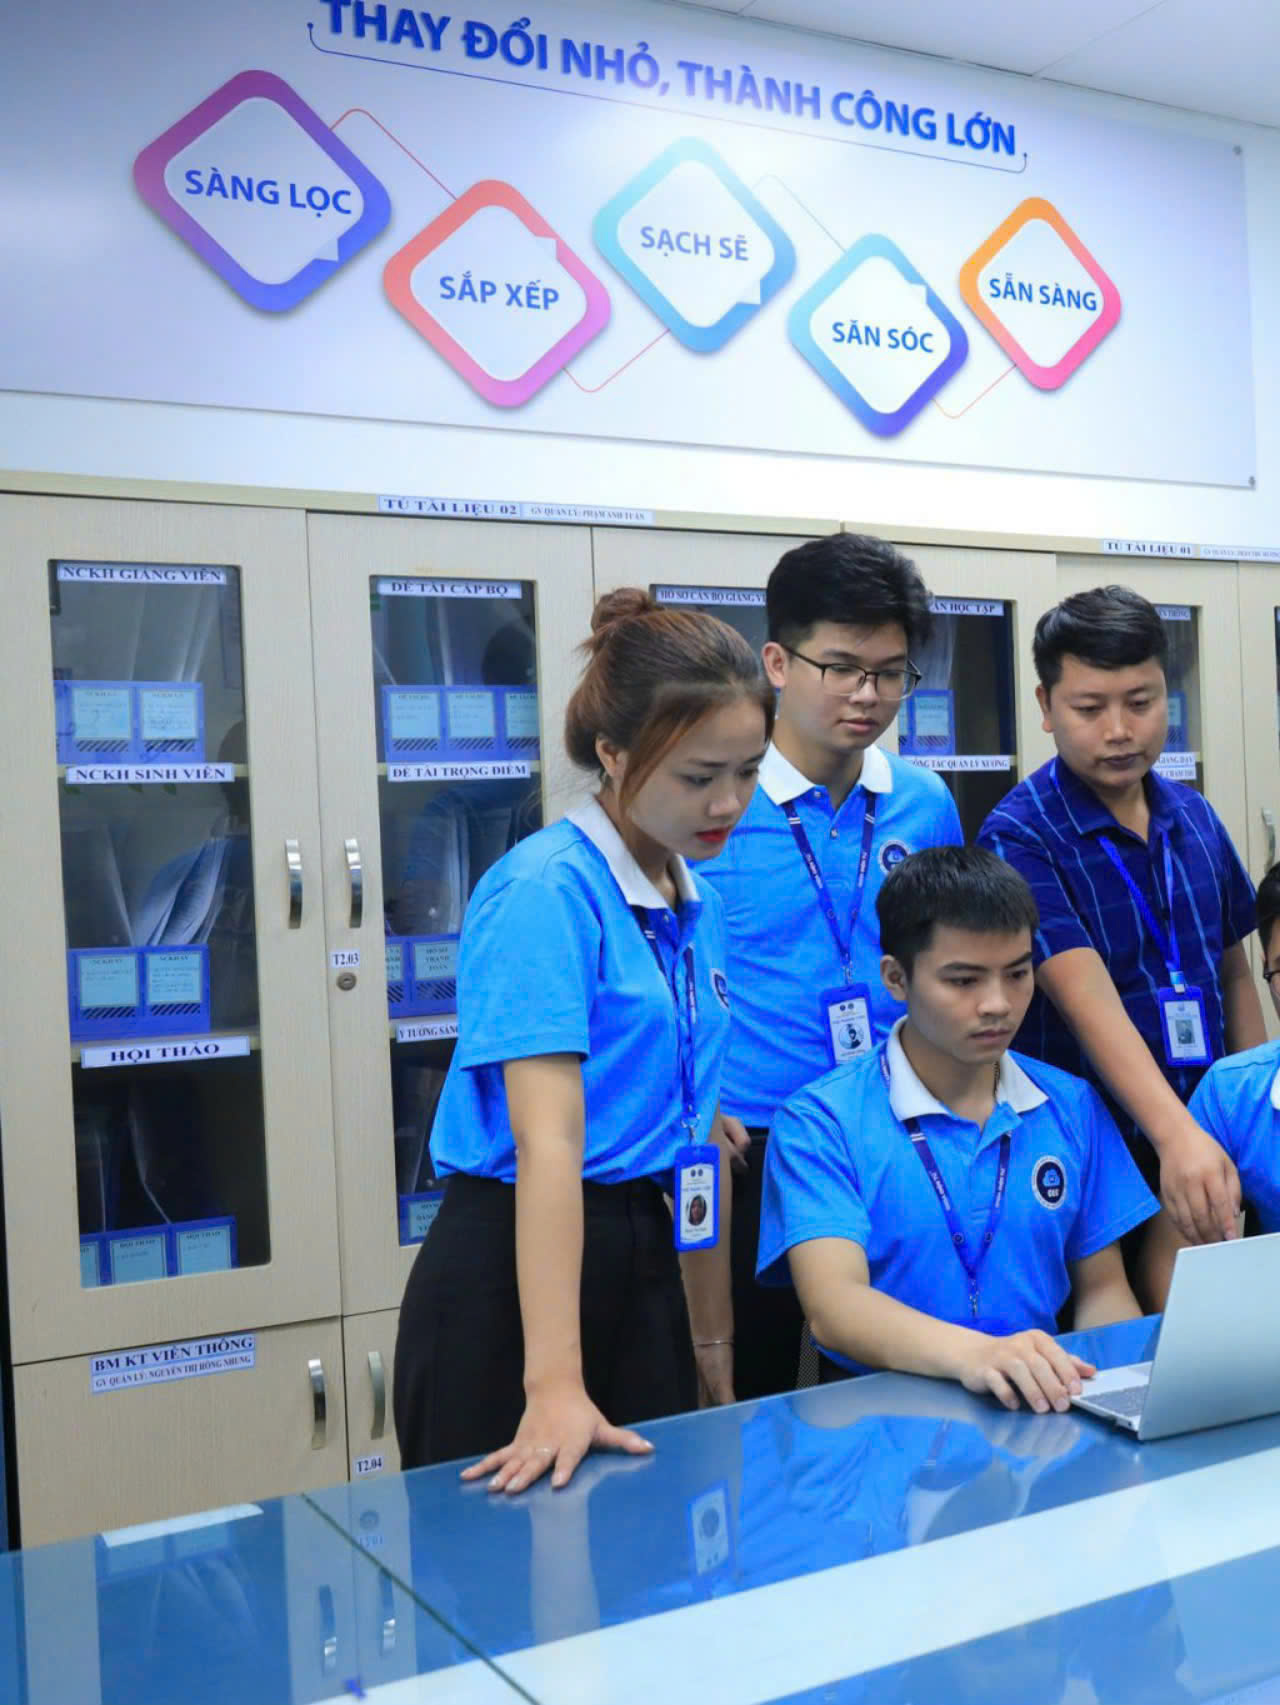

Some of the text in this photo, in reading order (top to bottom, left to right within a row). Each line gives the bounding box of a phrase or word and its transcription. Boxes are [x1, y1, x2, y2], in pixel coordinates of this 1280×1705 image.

[321, 0, 1016, 156] THAY ĐỔI NHỎ, THÀNH CÔNG LỚN
[185, 168, 352, 218] SÀNG LỌC
[640, 225, 750, 261] SẠCH SẼ
[439, 274, 560, 311] SẮP XẾP
[989, 272, 1098, 312] SẴN SÀNG
[831, 319, 935, 353] SĂN SÓC
[414, 498, 446, 512] TÀI
[452, 500, 496, 516] LIỆU
[500, 504, 518, 515] 02
[63, 566, 114, 580] NCKH
[182, 567, 221, 582] VIÊN
[76, 765, 225, 781] NCKH SINH VIÊN
[440, 764, 489, 780] TRỌNG
[333, 952, 359, 966] T2.03
[110, 1041, 220, 1064] HỘI THẢO
[95, 1357, 120, 1371] BM
[125, 1353, 150, 1367] KT
[194, 1336, 253, 1354] THÔNG
[356, 1457, 382, 1472] T2.04
